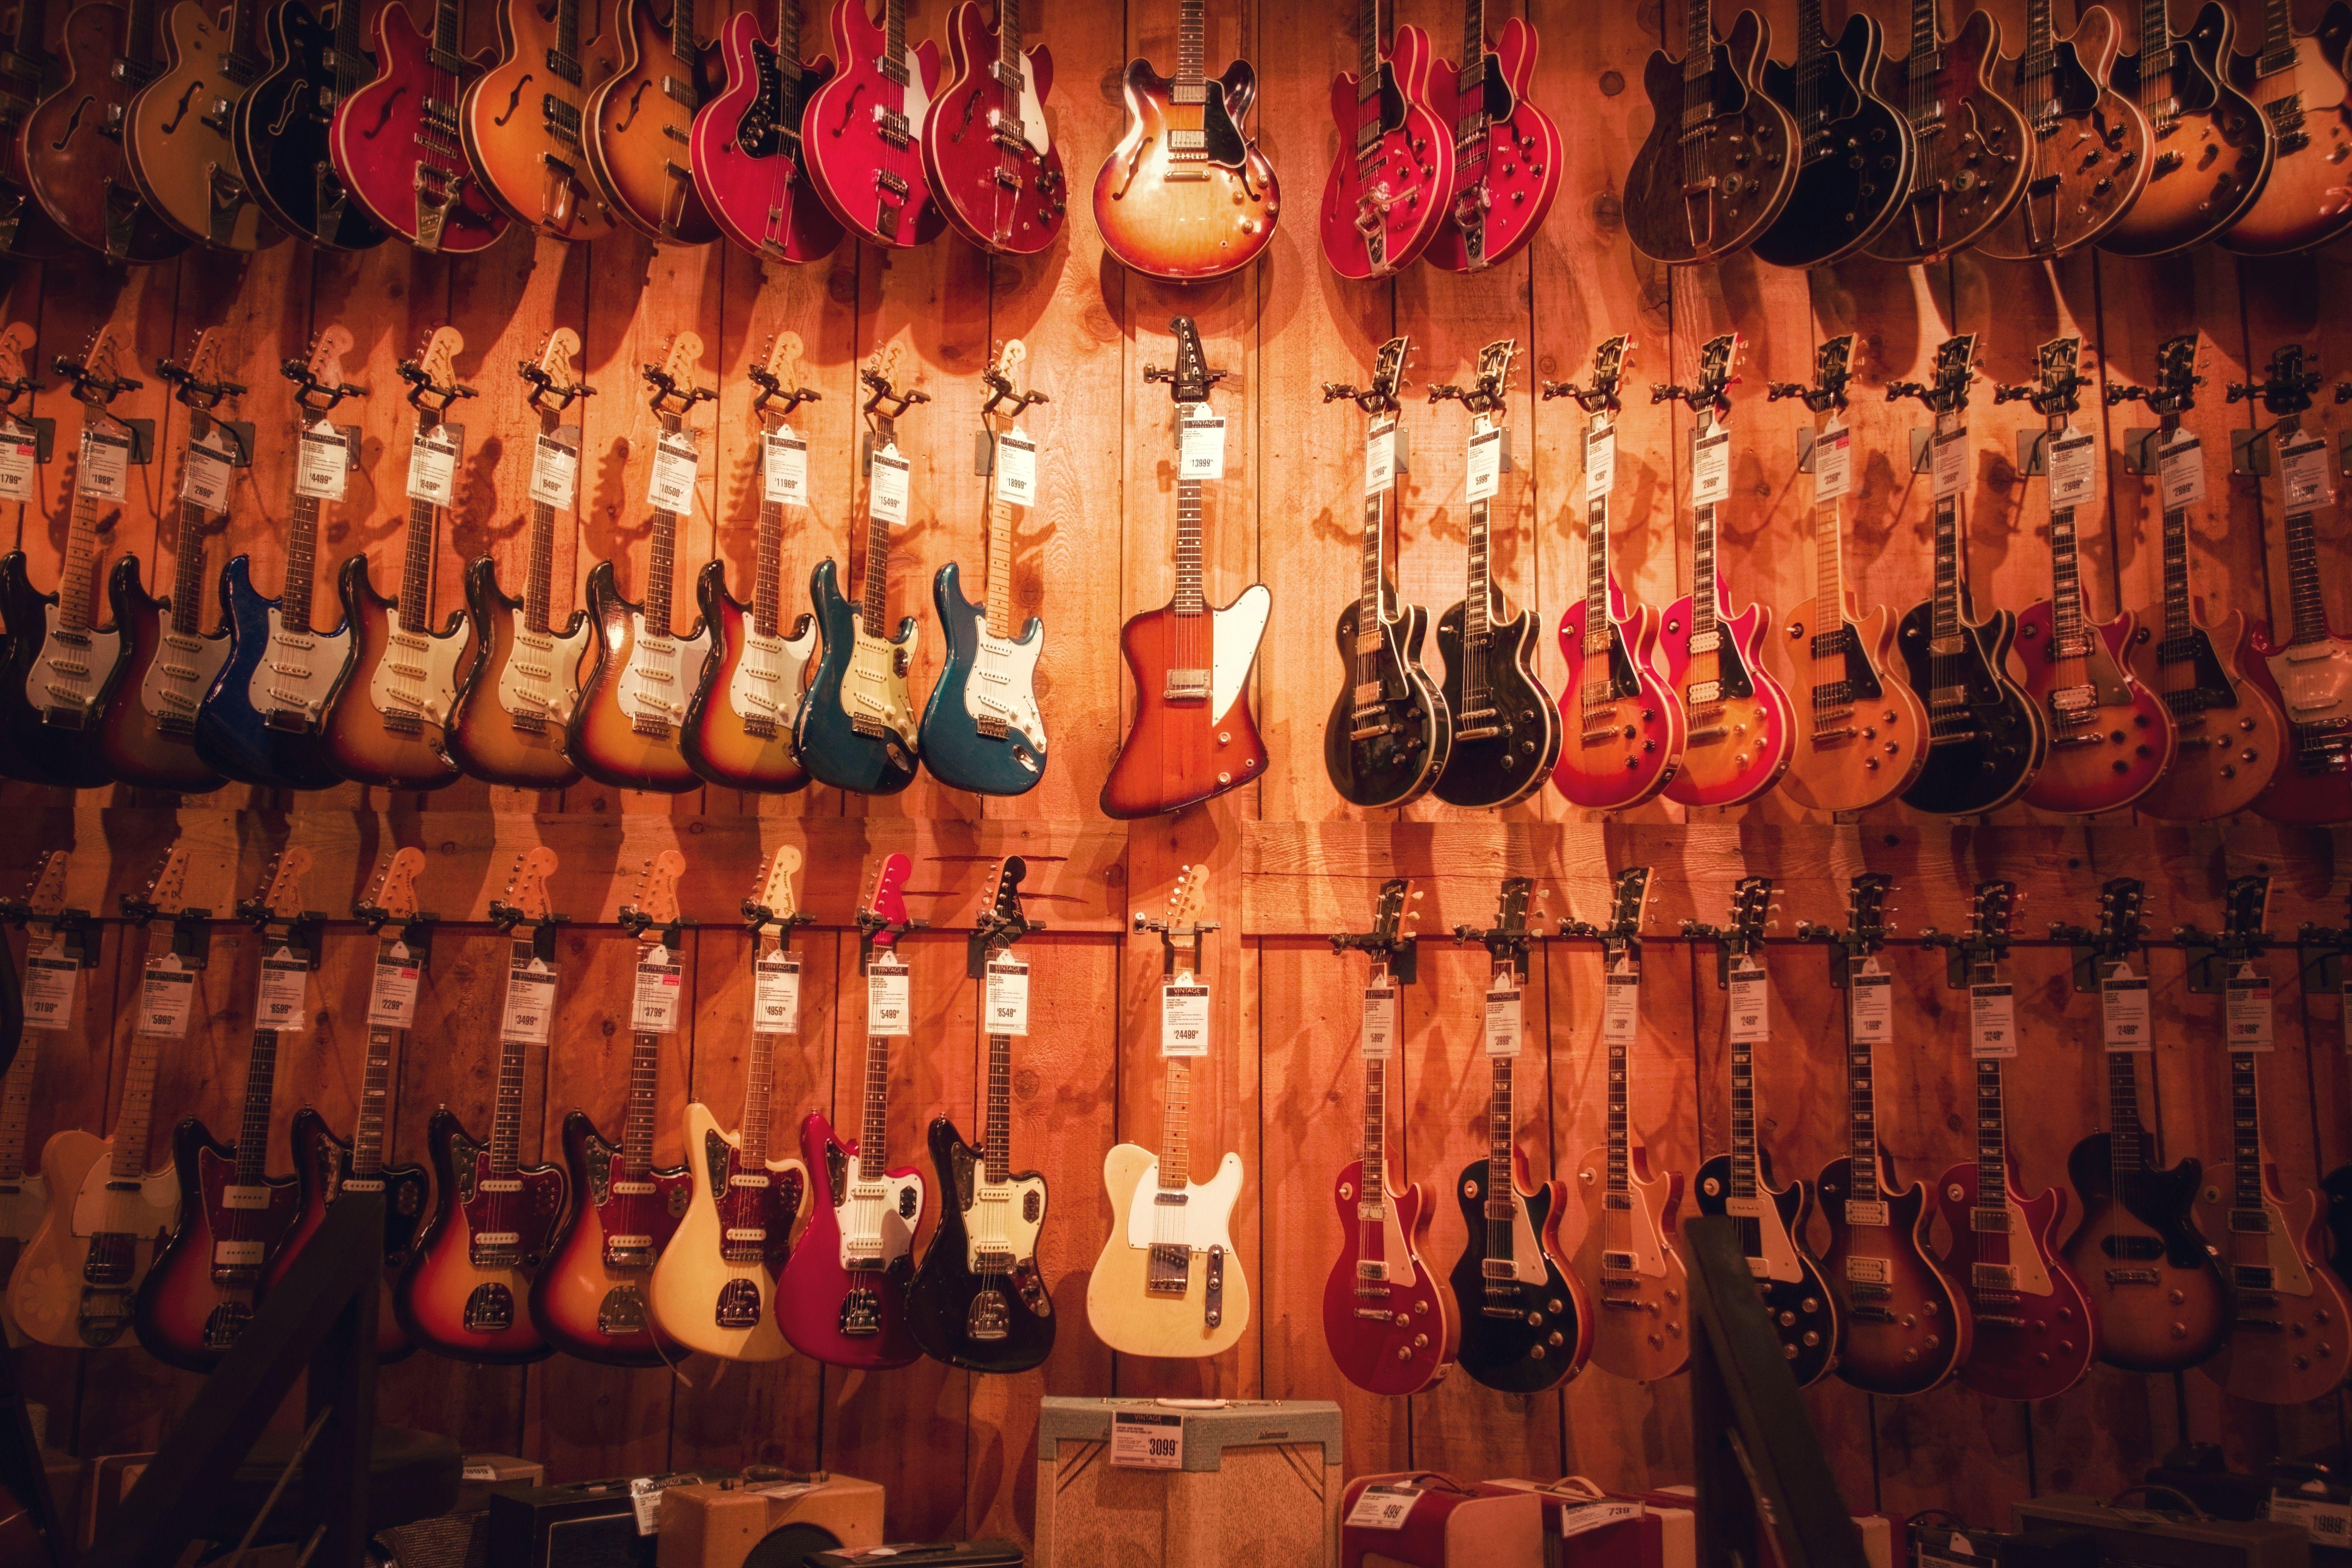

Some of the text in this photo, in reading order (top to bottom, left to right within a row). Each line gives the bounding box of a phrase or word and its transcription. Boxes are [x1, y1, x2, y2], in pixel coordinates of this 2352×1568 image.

[1488, 344, 1504, 356] Gibson
[1603, 339, 1618, 352] Gibson
[310, 432, 338, 442] VINTAGE
[774, 438, 800, 447] VINTAGE
[1007, 437, 1029, 447] VINTAGE
[1475, 432, 1494, 443] VINTAGE
[1702, 435, 1722, 446] VINTAGE
[2059, 439, 2086, 448] VINTAGE
[666, 444, 692, 457] VINTAGE
[880, 456, 902, 467] VINTAGE
[1624, 870, 1641, 882] Gibson
[171, 878, 184, 900] Fender
[1742, 879, 1761, 892] Gibson
[2236, 879, 2257, 891] Gibson
[1386, 885, 1401, 897] Gibson
[1983, 885, 2004, 898] Gibson
[784, 893, 796, 915] Fender
[1012, 895, 1022, 918] Fender
[766, 1006, 782, 1015] $4959
[880, 1009, 896, 1019] $5499
[997, 1008, 1013, 1017] $8549
[1174, 1030, 1196, 1039] $24499
[1135, 1414, 1162, 1422] VINTAGE
[1148, 1438, 1176, 1456] $3099
[656, 1479, 682, 1488] VINTAGE
[1383, 1504, 1402, 1518] $499
